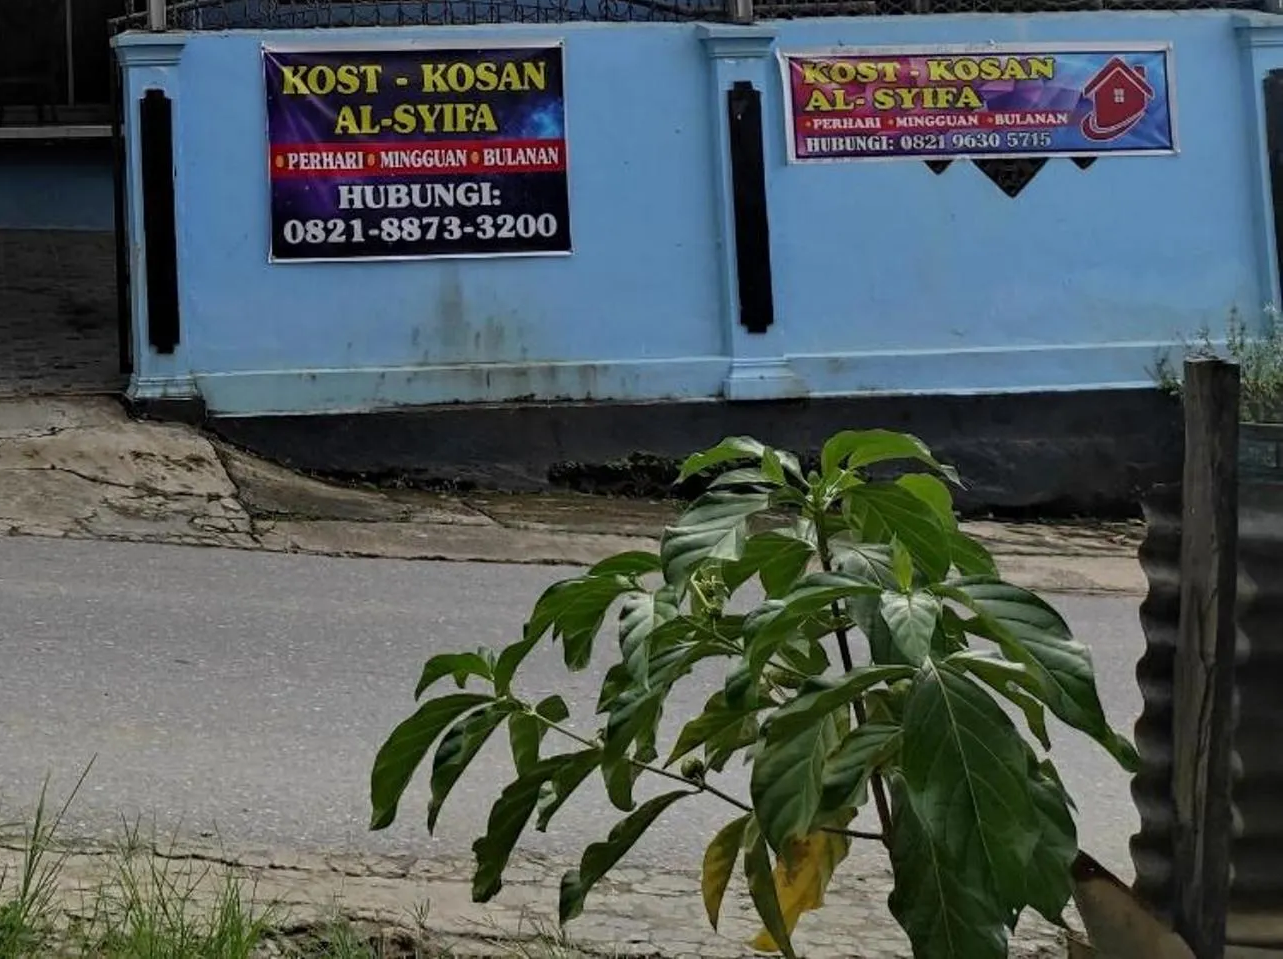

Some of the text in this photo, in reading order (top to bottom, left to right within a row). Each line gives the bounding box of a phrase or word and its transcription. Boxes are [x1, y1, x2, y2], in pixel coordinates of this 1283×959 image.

[282, 64, 383, 95] KOST
[421, 61, 546, 93] KOSAN
[802, 61, 901, 84] KOST
[927, 57, 1055, 81] KOSAN
[334, 103, 498, 135] AL-SYIFA
[813, 113, 1068, 130] PERHARI MINGGUAN BULANAN
[805, 132, 1051, 153] HUBUNGI: 0821 9630 5715
[287, 147, 559, 170] PERHARI MINGGUAN BULANAN
[338, 182, 501, 210] HUBUNGI:
[283, 213, 558, 244] 0821-8873-3200
